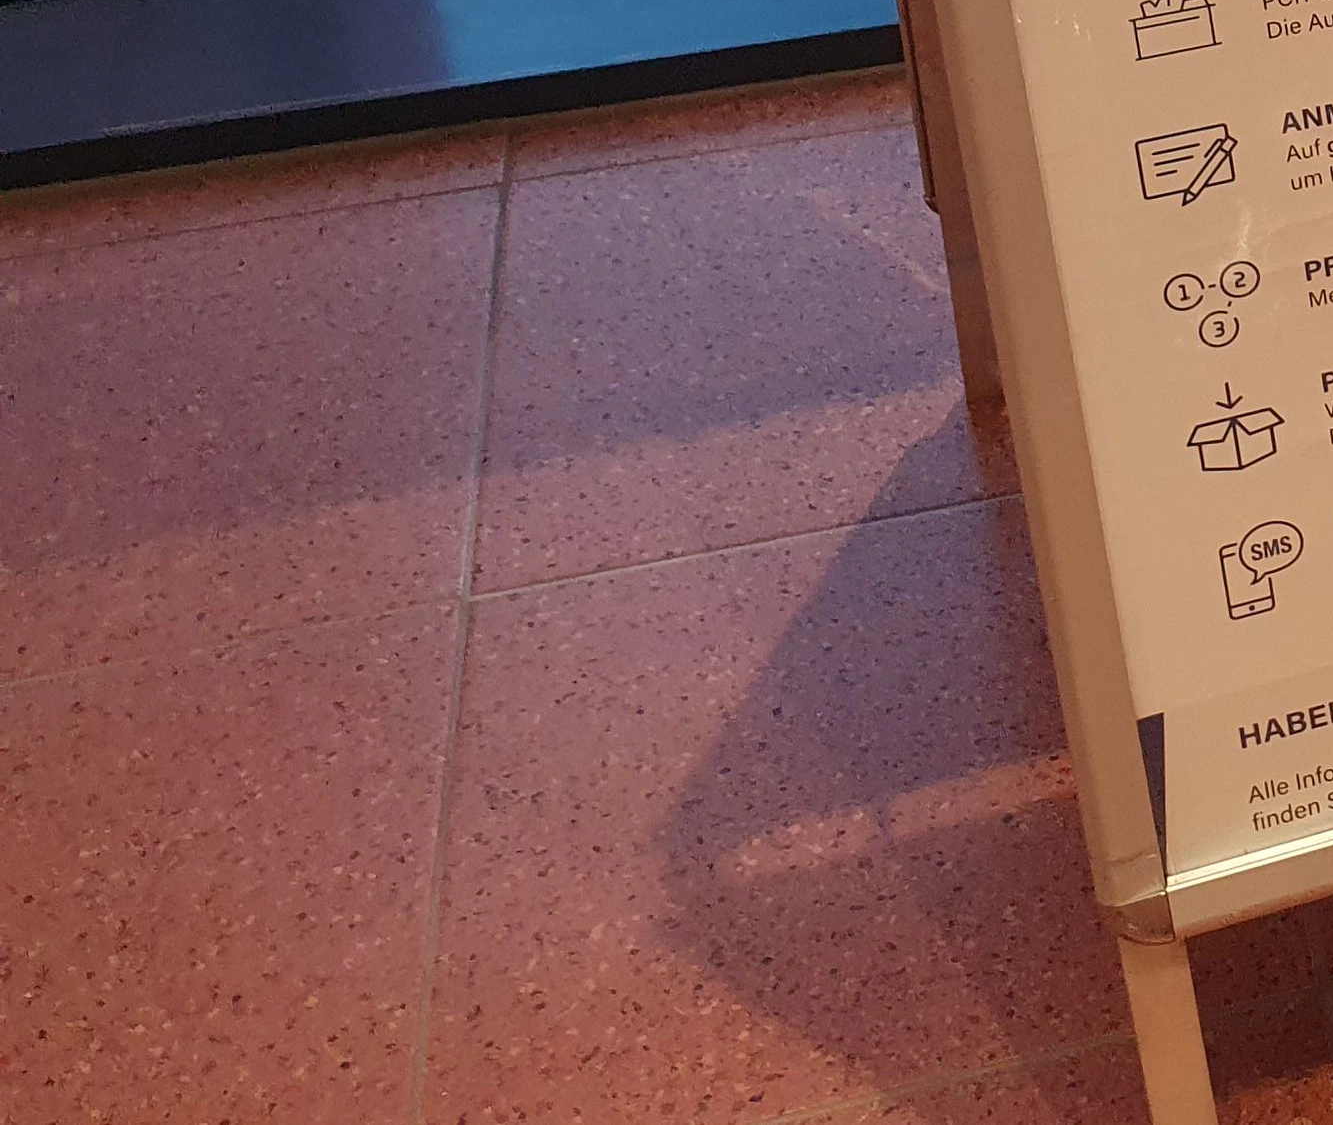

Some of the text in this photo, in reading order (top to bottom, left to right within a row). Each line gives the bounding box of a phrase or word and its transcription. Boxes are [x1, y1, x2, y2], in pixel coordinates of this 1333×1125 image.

[1266, 18, 1301, 39] Die
[1178, 271, 1246, 301] 1 2
[1214, 321, 1226, 337] 3
[1250, 535, 1293, 561] SMS
[1252, 801, 1320, 831] finden
